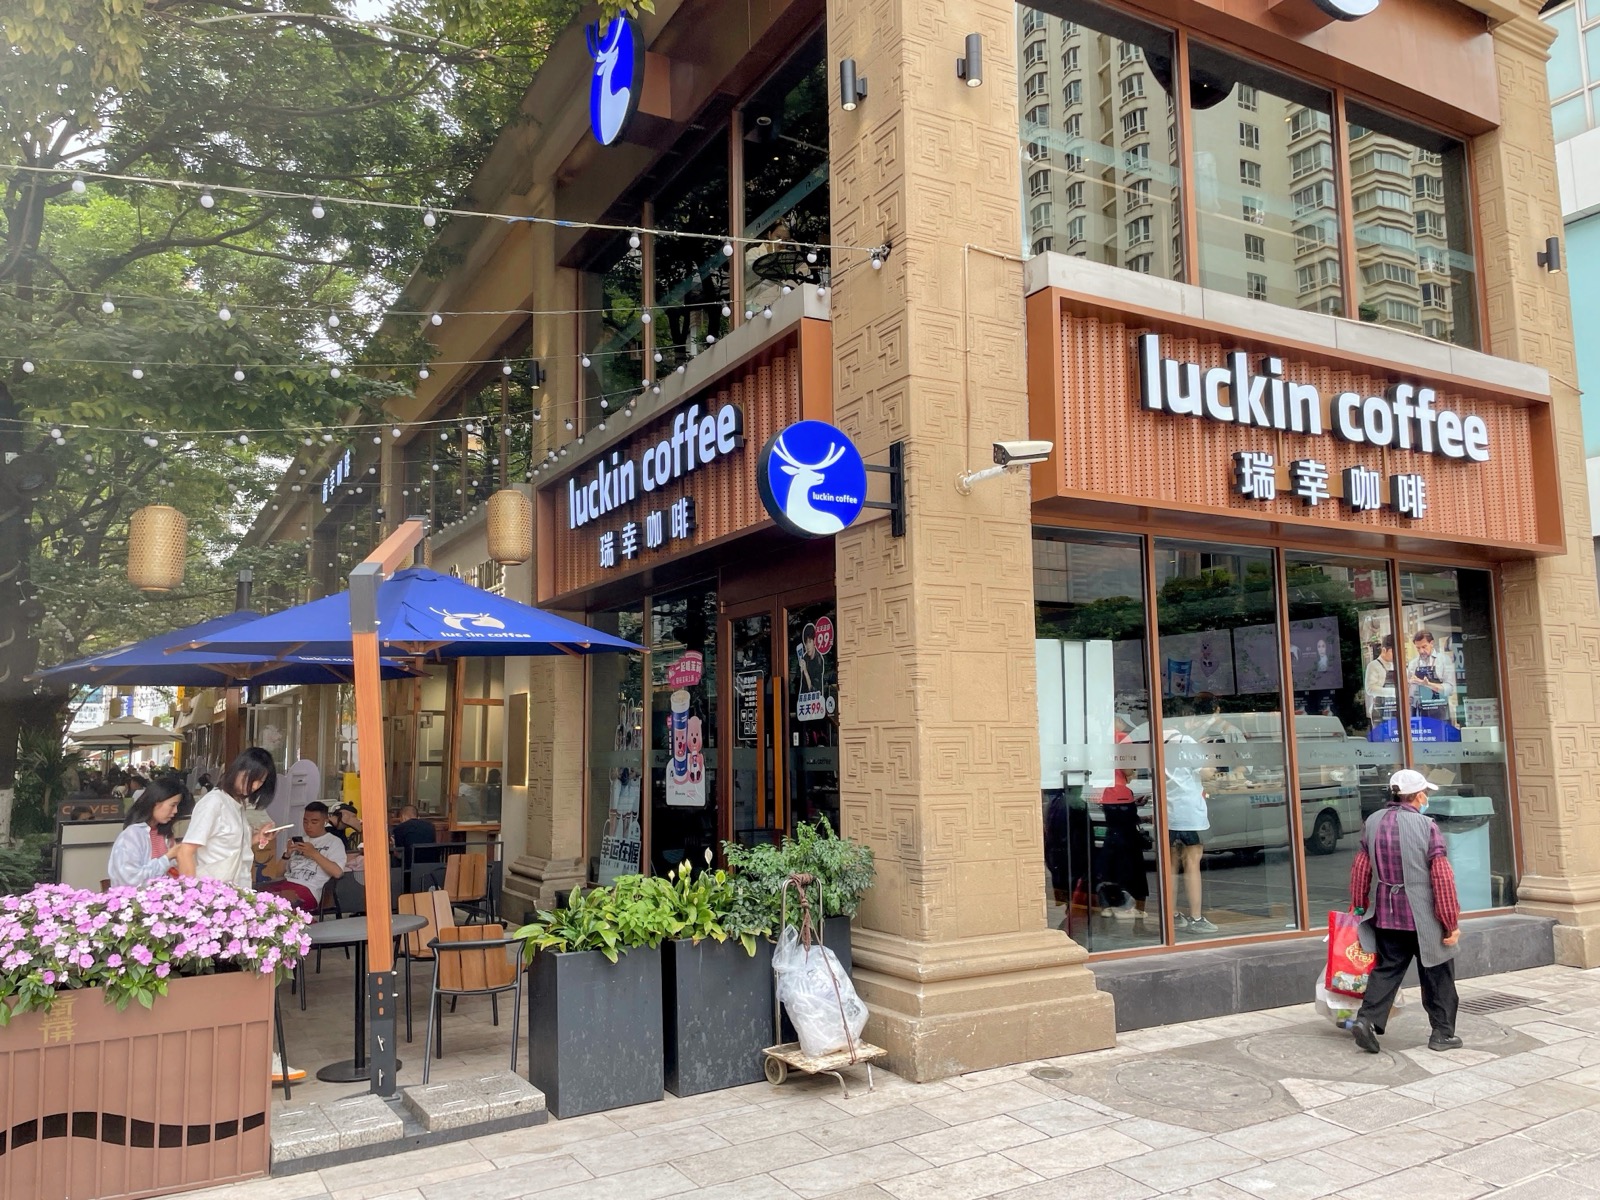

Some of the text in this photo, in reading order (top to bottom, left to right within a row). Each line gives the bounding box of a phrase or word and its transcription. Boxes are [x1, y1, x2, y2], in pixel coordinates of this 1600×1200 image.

[1143, 333, 1490, 462] luckin coffee
[569, 404, 737, 529] luckin coffee
[812, 491, 858, 504] luckin coffee
[1238, 452, 1426, 518] 瑞幸咖啡
[600, 497, 689, 569] 瑞幸咖啡
[62, 804, 119, 815] CVES
[601, 835, 641, 864] 幸运在握
